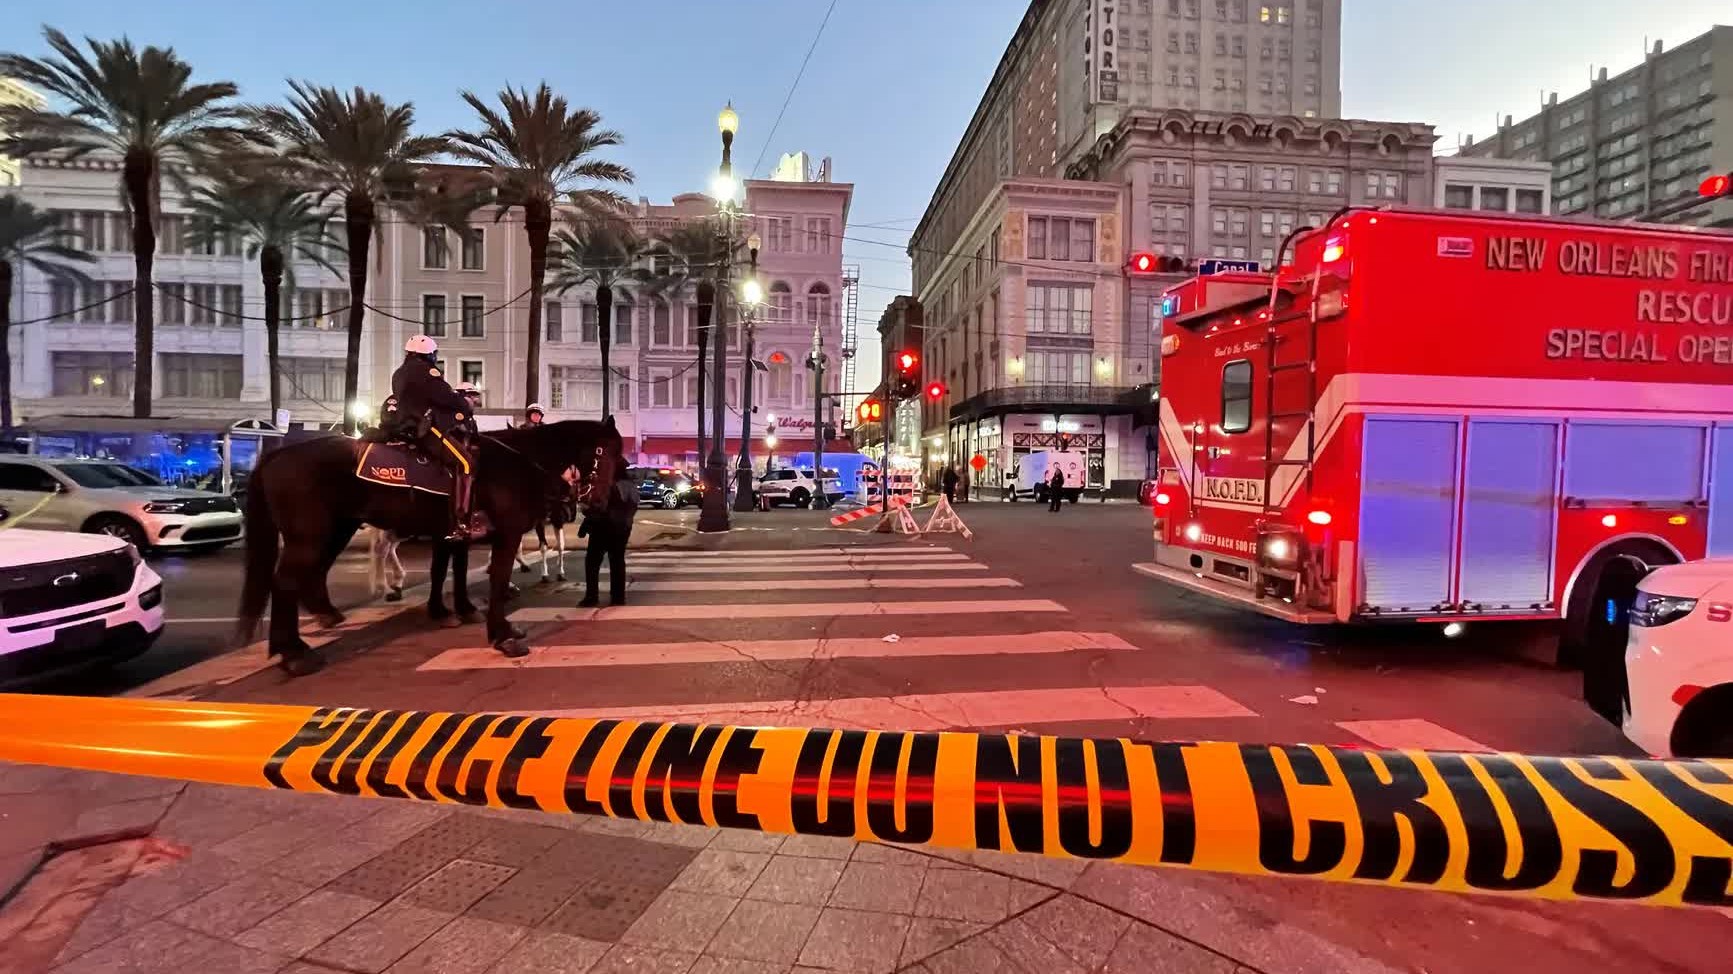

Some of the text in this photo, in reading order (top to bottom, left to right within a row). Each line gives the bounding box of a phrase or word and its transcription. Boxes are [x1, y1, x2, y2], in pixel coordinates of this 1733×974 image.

[1103, 0, 1114, 68] TOR
[1487, 236, 1548, 271] NEW
[1559, 240, 1680, 279] ORLEANS
[1546, 327, 1733, 364] SPECIAL OPE
[1206, 478, 1263, 502] N.O.F.D.
[1200, 533, 1216, 545] KEEP
[1217, 536, 1234, 549] BACK
[1235, 539, 1248, 552] 500
[263, 706, 556, 811] POLICE
[564, 720, 763, 830] LINE
[974, 733, 1198, 864] NOT
